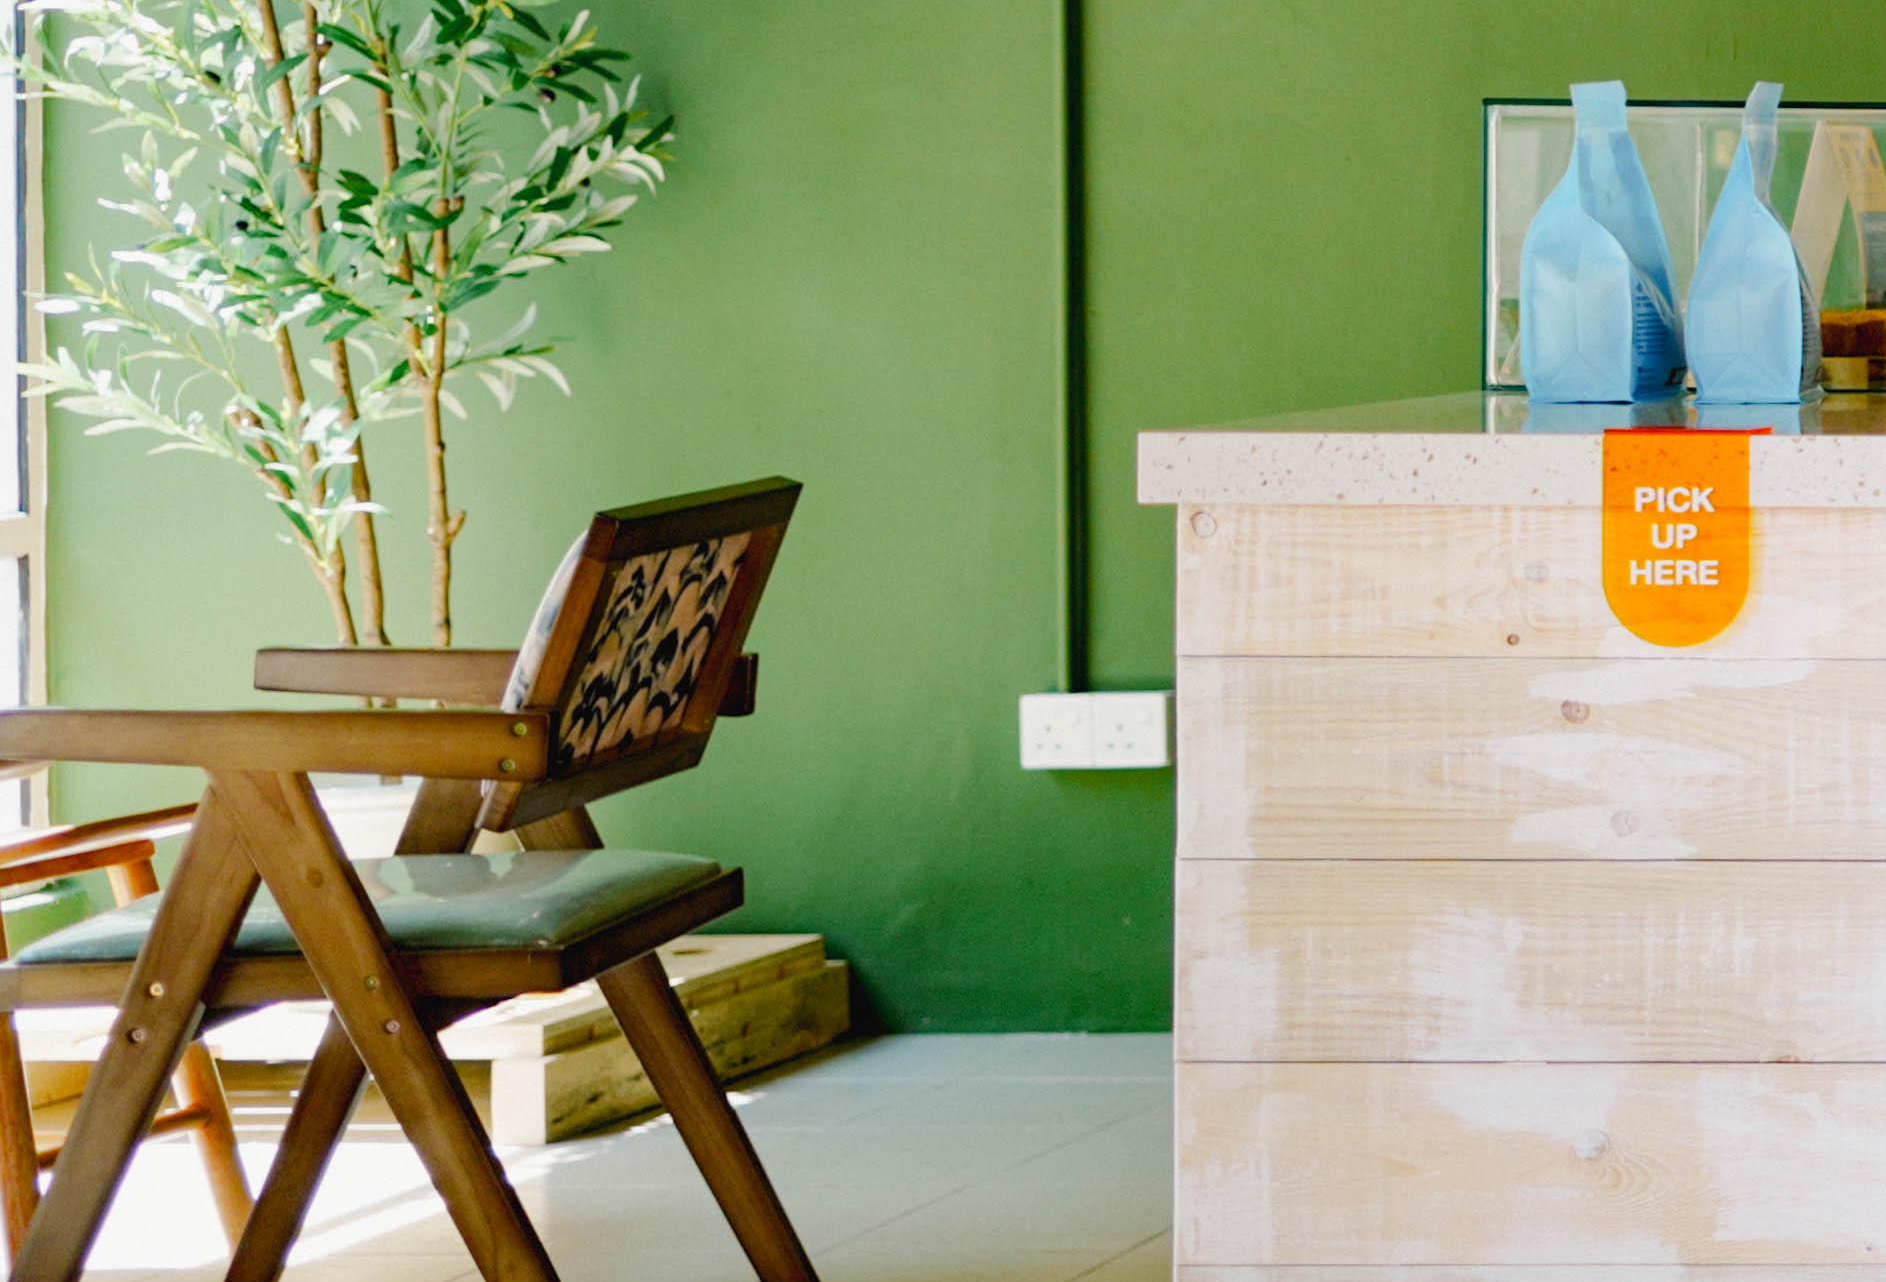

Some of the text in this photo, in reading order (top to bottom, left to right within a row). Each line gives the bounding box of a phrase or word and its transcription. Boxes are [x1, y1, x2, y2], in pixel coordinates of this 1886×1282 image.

[1634, 486, 1715, 513] PICK
[1651, 523, 1698, 549] UP
[1629, 559, 1719, 586] HERE
